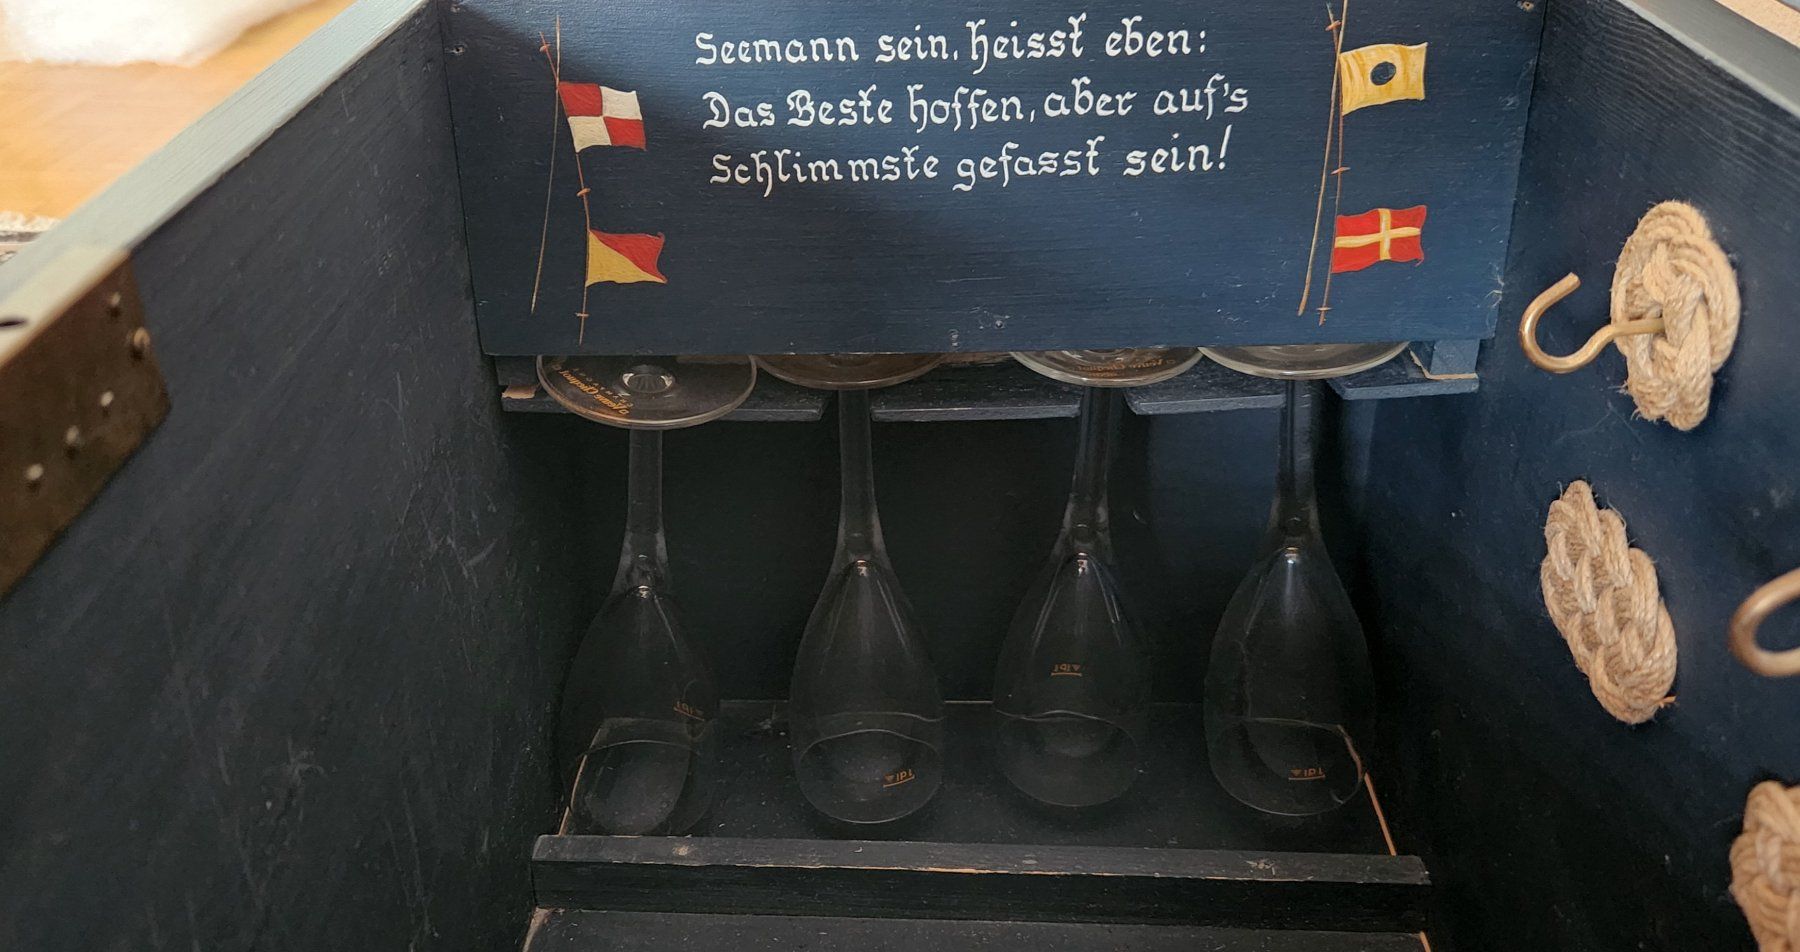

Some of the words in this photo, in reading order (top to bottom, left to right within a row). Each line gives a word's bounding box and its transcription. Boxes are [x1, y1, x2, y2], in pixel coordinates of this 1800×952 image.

[965, 12, 1087, 75] heisst
[1105, 15, 1206, 58] eben:
[702, 91, 776, 130] Das
[786, 83, 893, 127] Beste
[1043, 76, 1138, 118] aber
[952, 135, 1106, 192] gefasst
[1122, 124, 1233, 176] sein!
